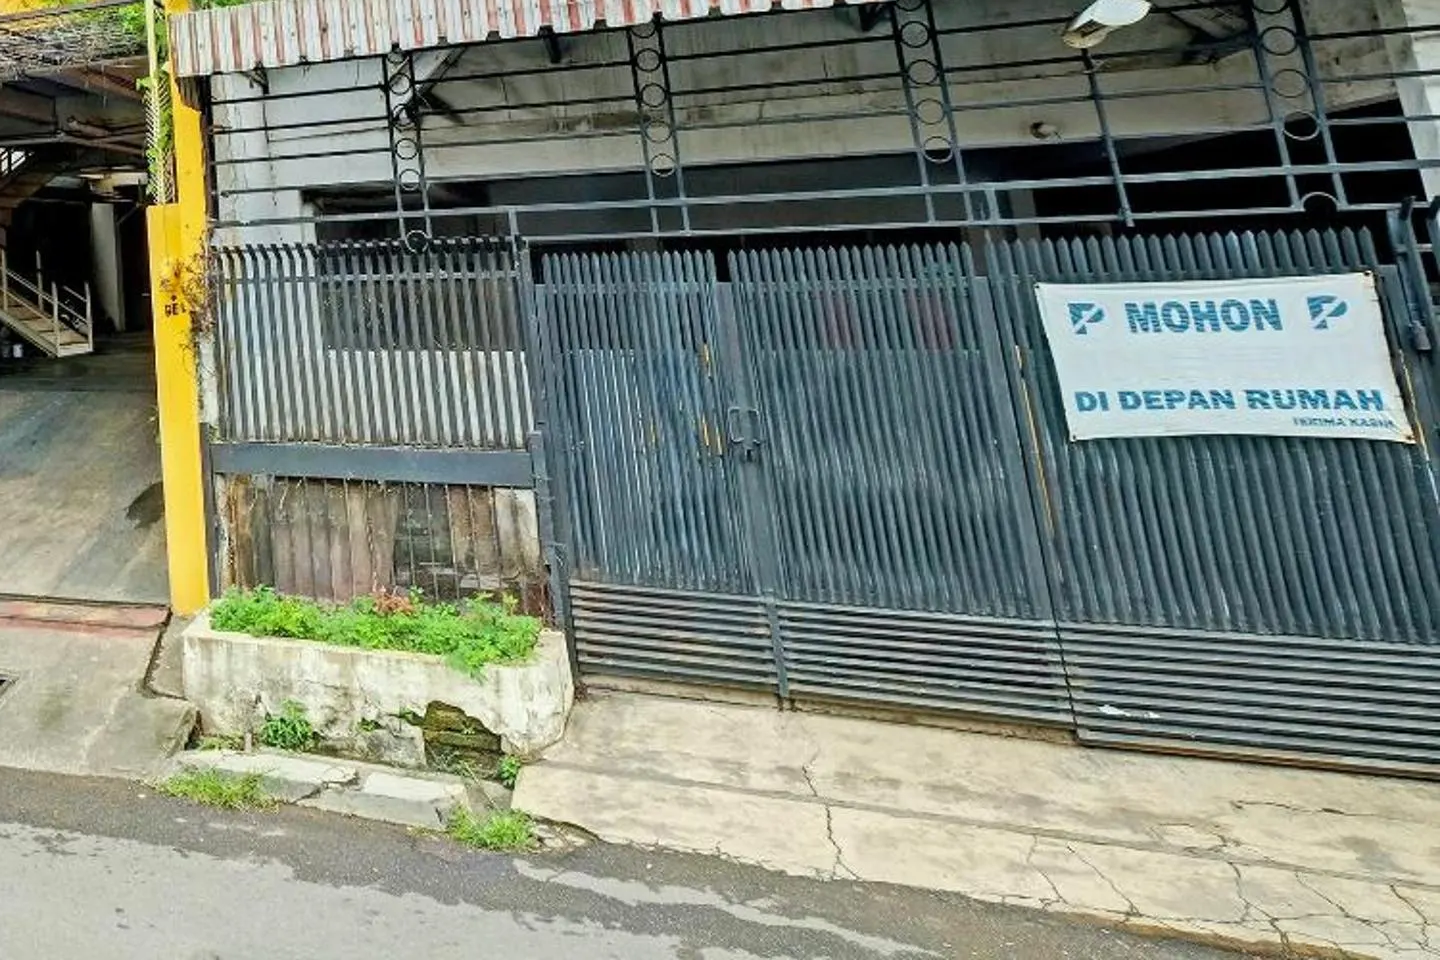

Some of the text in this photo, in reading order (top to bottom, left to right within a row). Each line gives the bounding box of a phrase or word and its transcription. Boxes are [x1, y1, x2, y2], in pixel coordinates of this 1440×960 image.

[1125, 298, 1283, 334] MOHON
[1074, 389, 1384, 413] DI DEPAN RUMAH
